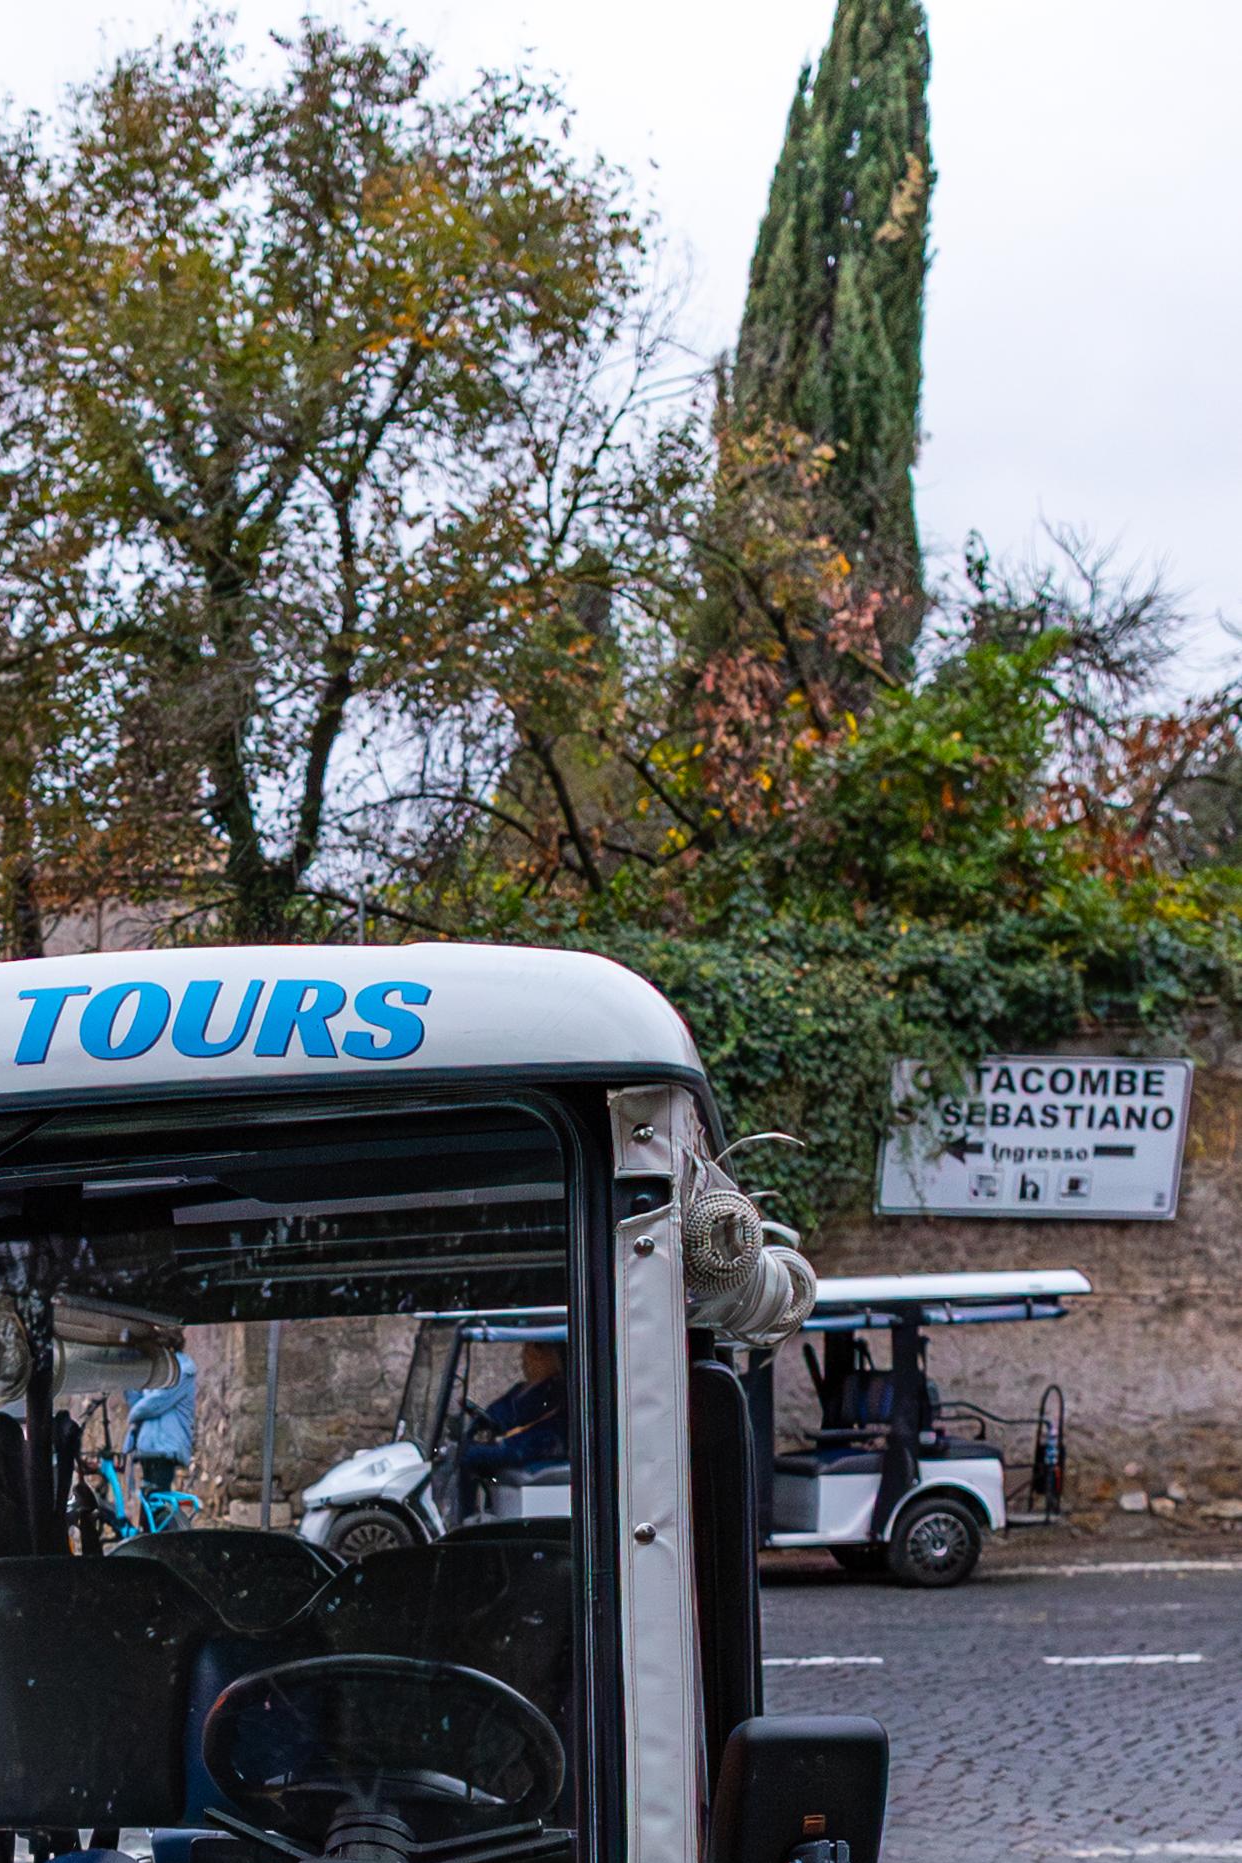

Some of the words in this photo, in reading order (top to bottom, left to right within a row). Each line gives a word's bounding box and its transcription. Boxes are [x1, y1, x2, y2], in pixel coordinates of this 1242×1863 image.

[916, 1067, 1166, 1097] TACOMBE
[941, 1102, 1174, 1130] SEBASTIANO
[991, 1143, 1088, 1164] Ingresso
